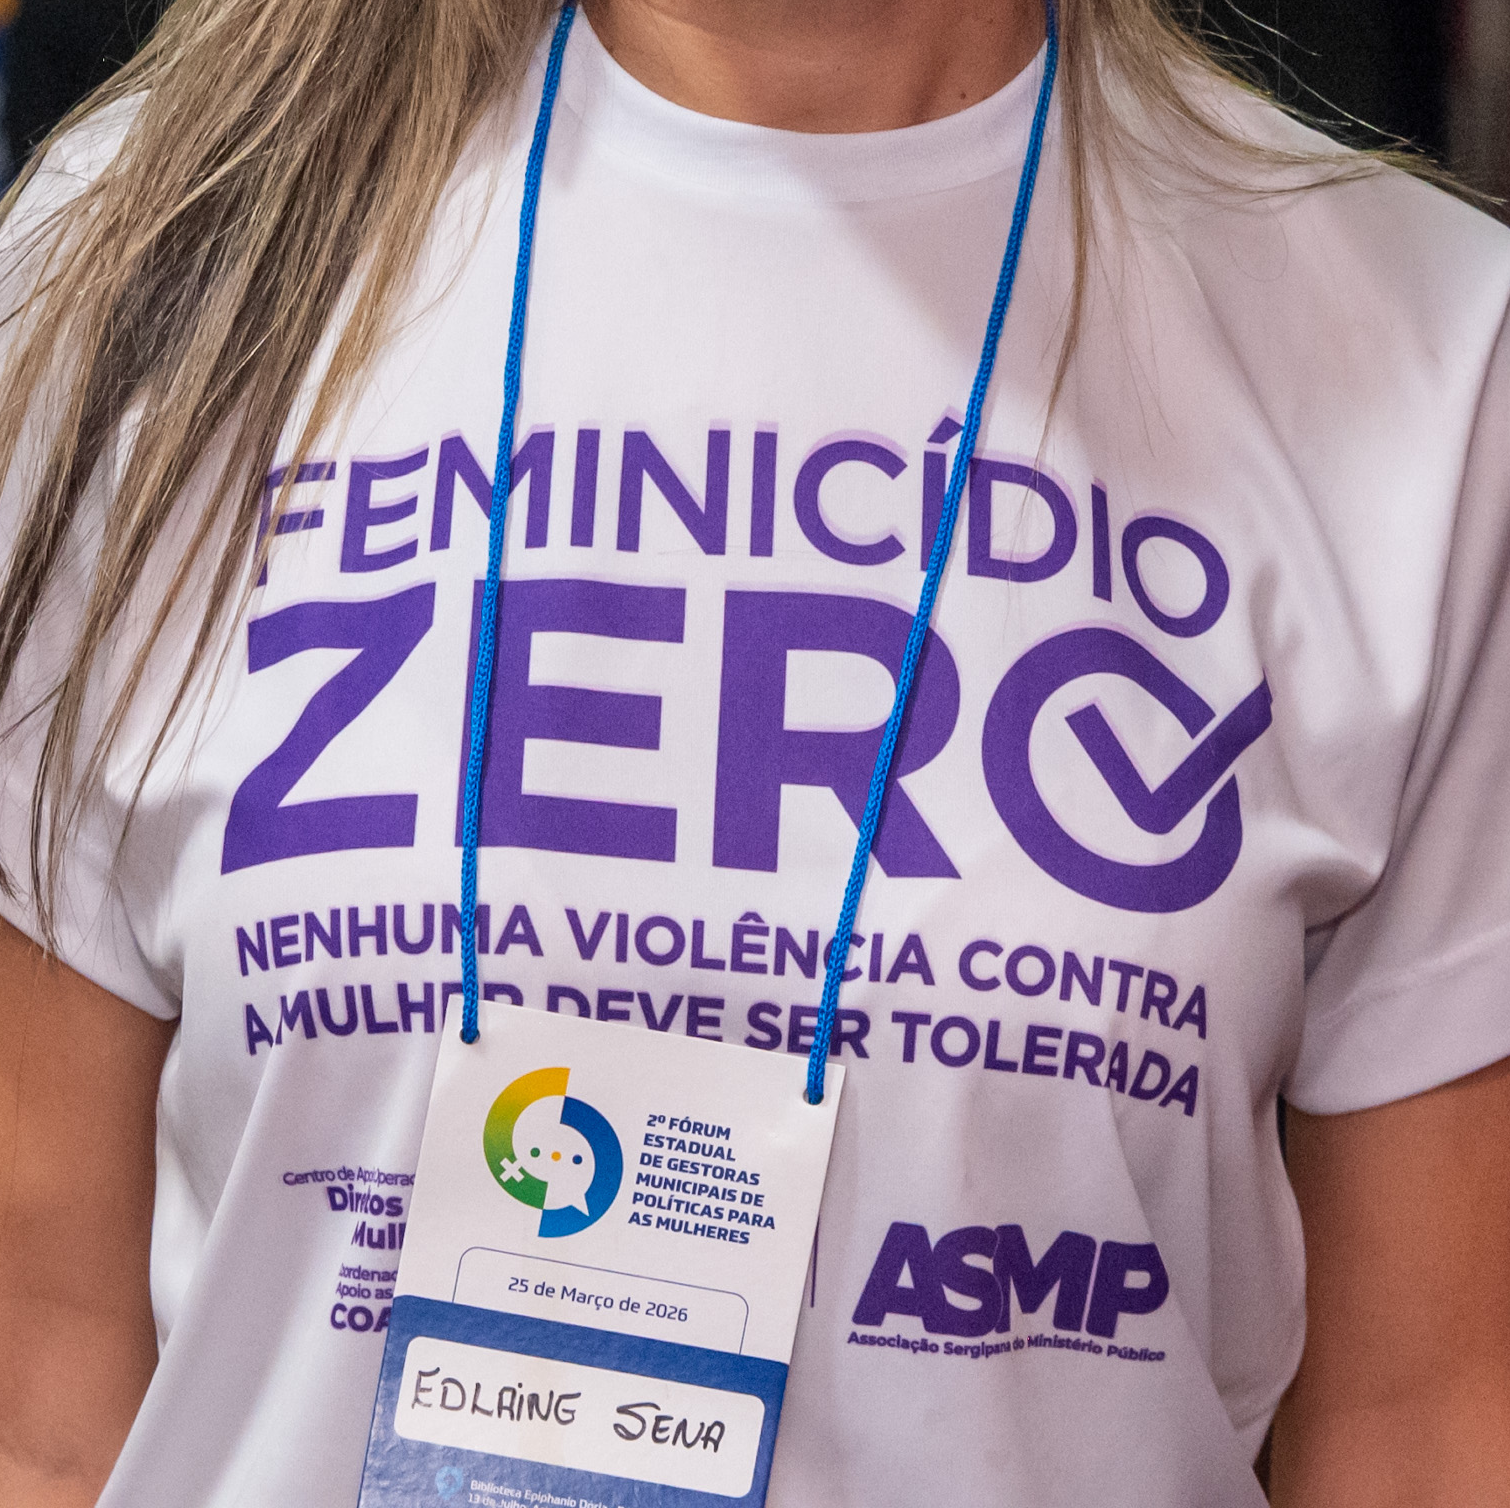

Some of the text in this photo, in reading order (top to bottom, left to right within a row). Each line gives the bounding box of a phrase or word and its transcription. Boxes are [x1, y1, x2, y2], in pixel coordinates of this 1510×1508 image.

[255, 407, 1230, 638] FEMINICÍDIO
[220, 576, 1251, 914] ZERO
[235, 903, 1208, 1040] NENHUMA VIOLÊNCIA CONTRA
[243, 1002, 275, 1056] A
[744, 1001, 871, 1059] SER
[891, 1010, 1200, 1118] TOLERADA
[643, 1132, 737, 1162] ESTADUAL
[668, 1116, 731, 1140] FÓRUM
[283, 1169, 336, 1186] Centro
[337, 1165, 355, 1181] de
[639, 1152, 761, 1186] DE GESTORAS
[635, 1172, 765, 1207] MUNICIPAIS DE
[628, 1211, 751, 1244] AS MULHERES
[632, 1191, 776, 1230] POLÍTICAS PARA
[507, 1277, 689, 1322] 25 de Março de 2026
[852, 1221, 1170, 1339] ASMP
[847, 1331, 940, 1354] Associação
[1012, 1337, 1025, 1351] do
[1027, 1333, 1103, 1355] Ministério
[1107, 1344, 1166, 1362] Público
[613, 1402, 726, 1453] SENA
